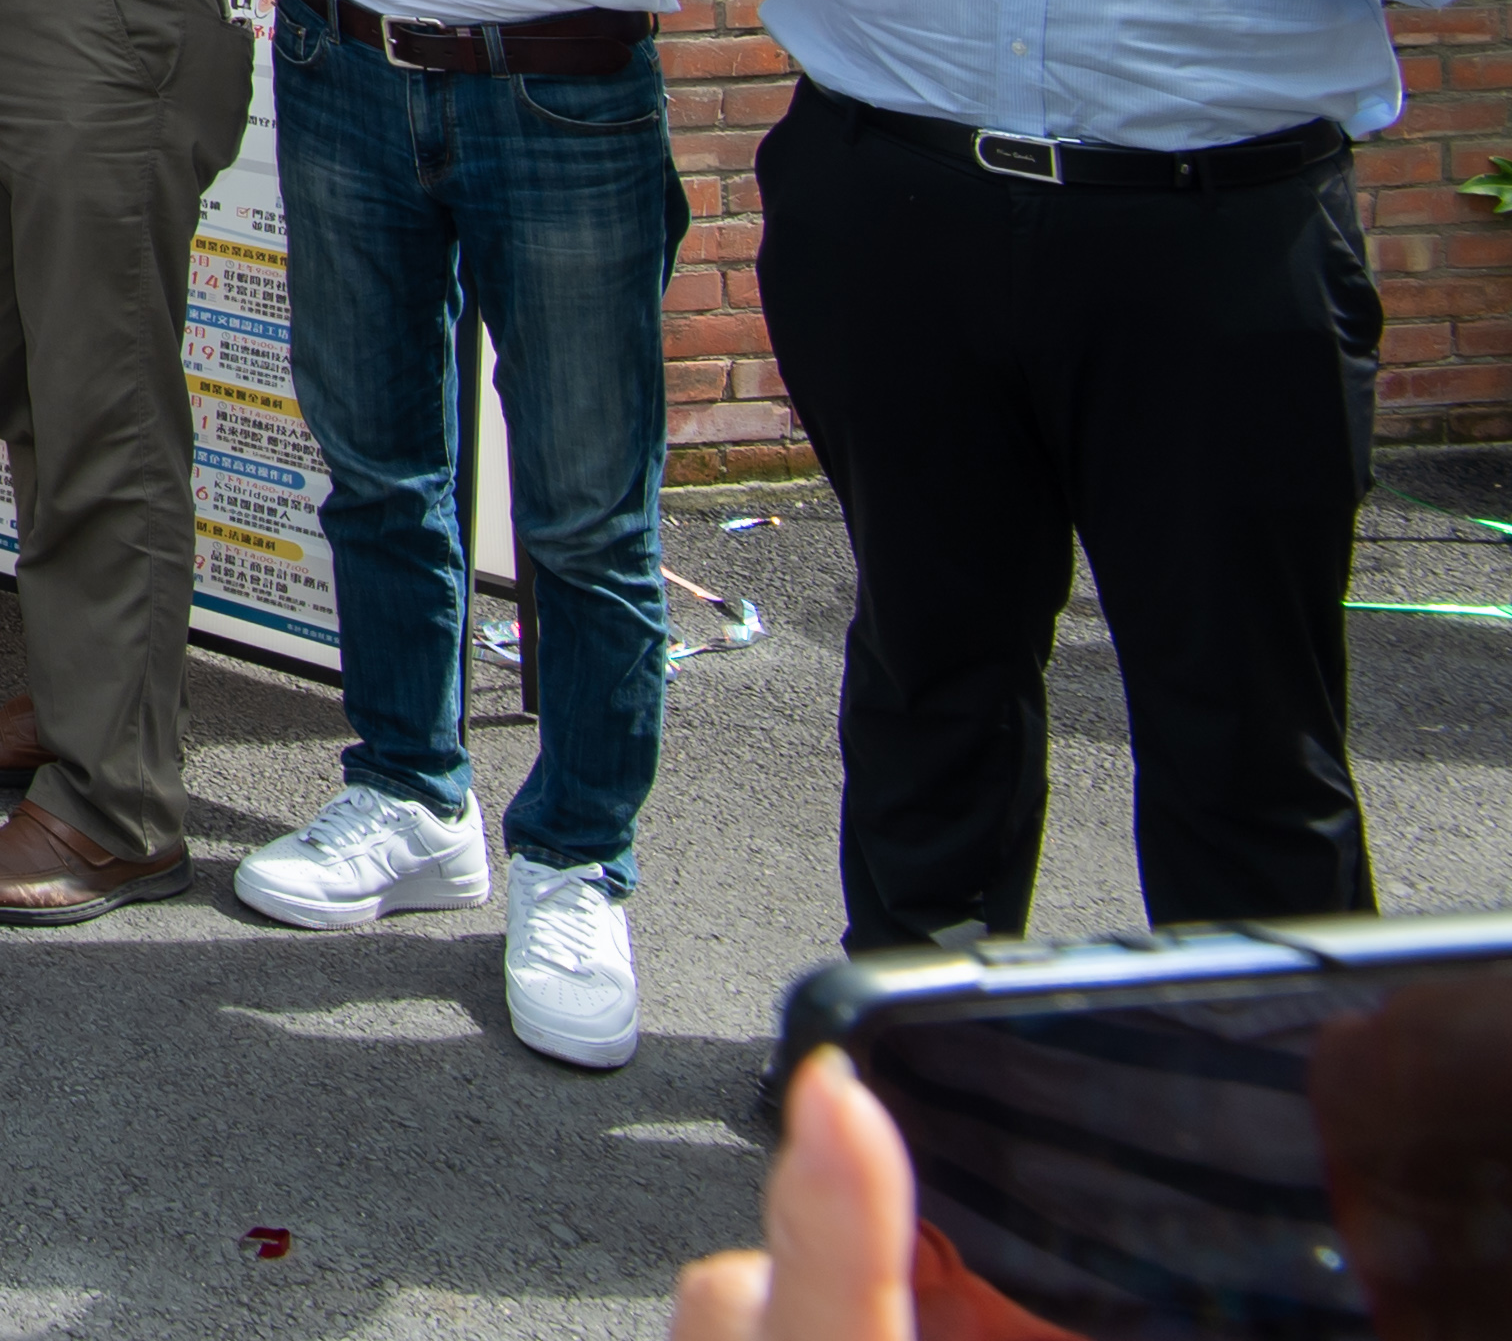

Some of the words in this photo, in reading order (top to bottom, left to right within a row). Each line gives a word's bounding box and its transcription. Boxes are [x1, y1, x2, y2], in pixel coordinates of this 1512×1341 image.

[192, 270, 219, 290] 14
[188, 342, 215, 361] 19
[193, 448, 294, 486] 業企業高效操作科
